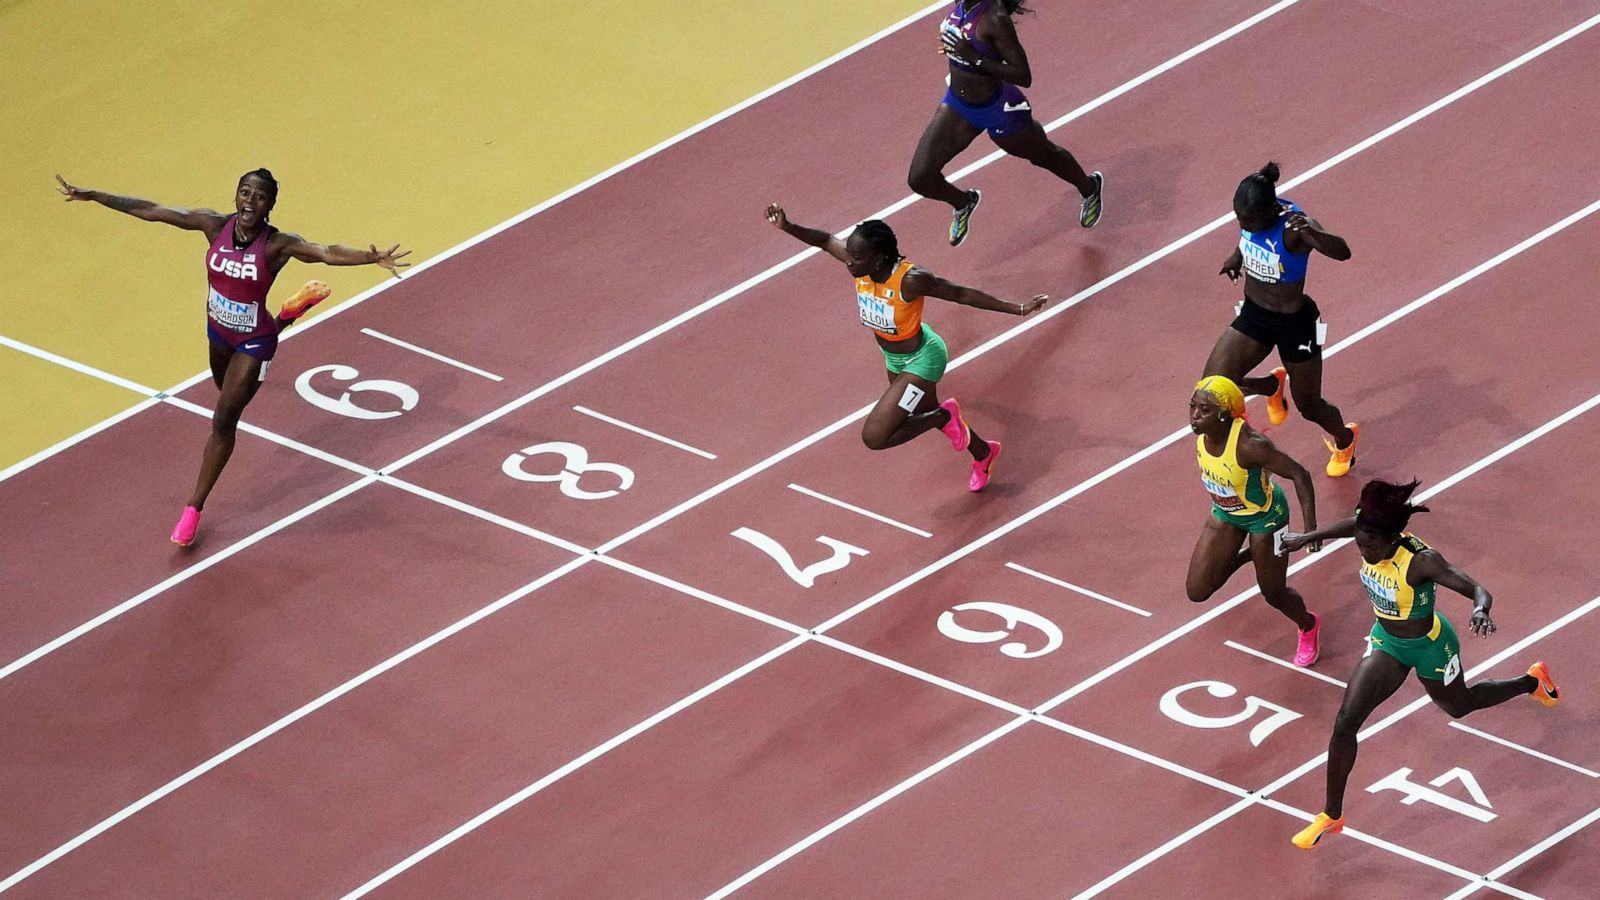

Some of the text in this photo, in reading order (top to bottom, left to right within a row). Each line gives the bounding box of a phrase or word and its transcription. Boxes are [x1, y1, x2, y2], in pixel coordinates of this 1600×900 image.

[1244, 242, 1270, 264] NTN
[209, 252, 258, 281] USA
[1245, 255, 1275, 276] LFRED
[215, 294, 248, 314] NTN
[858, 294, 885, 315] NTN
[870, 312, 889, 327] LOU
[295, 364, 420, 420] 9
[907, 391, 918, 406] 7
[502, 441, 636, 501] 8
[1200, 465, 1234, 488] AMAICA
[730, 526, 870, 588] 7
[1361, 573, 1387, 598] NTN
[936, 601, 1063, 659] 6
[1449, 662, 1456, 676] 4
[1159, 680, 1304, 747] 5
[1364, 767, 1498, 823] 4
